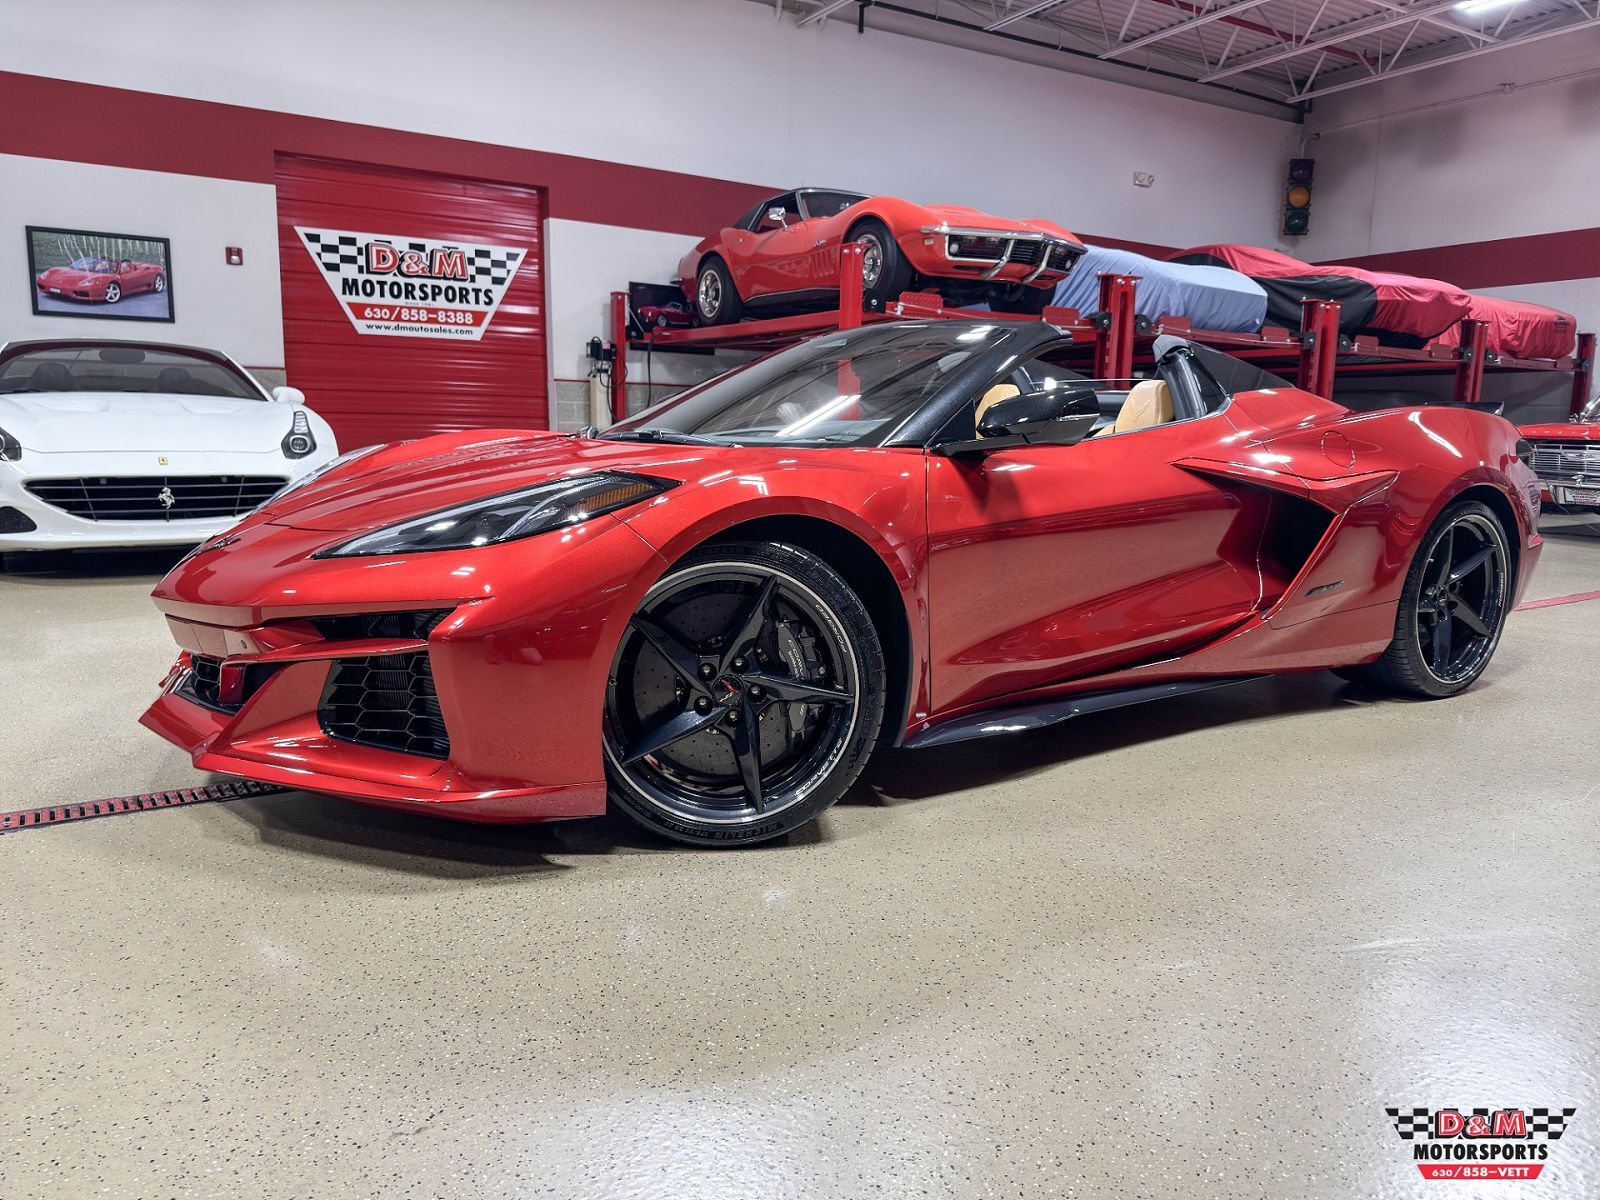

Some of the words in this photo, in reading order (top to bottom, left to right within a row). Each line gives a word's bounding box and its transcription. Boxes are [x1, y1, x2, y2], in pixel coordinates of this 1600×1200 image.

[366, 242, 469, 281] D&M
[341, 278, 494, 306] MOTORSPORTS
[364, 306, 474, 324] 630/858-8388
[365, 322, 474, 336] www.dmautosales.com
[793, 737, 843, 796] CORVETTE
